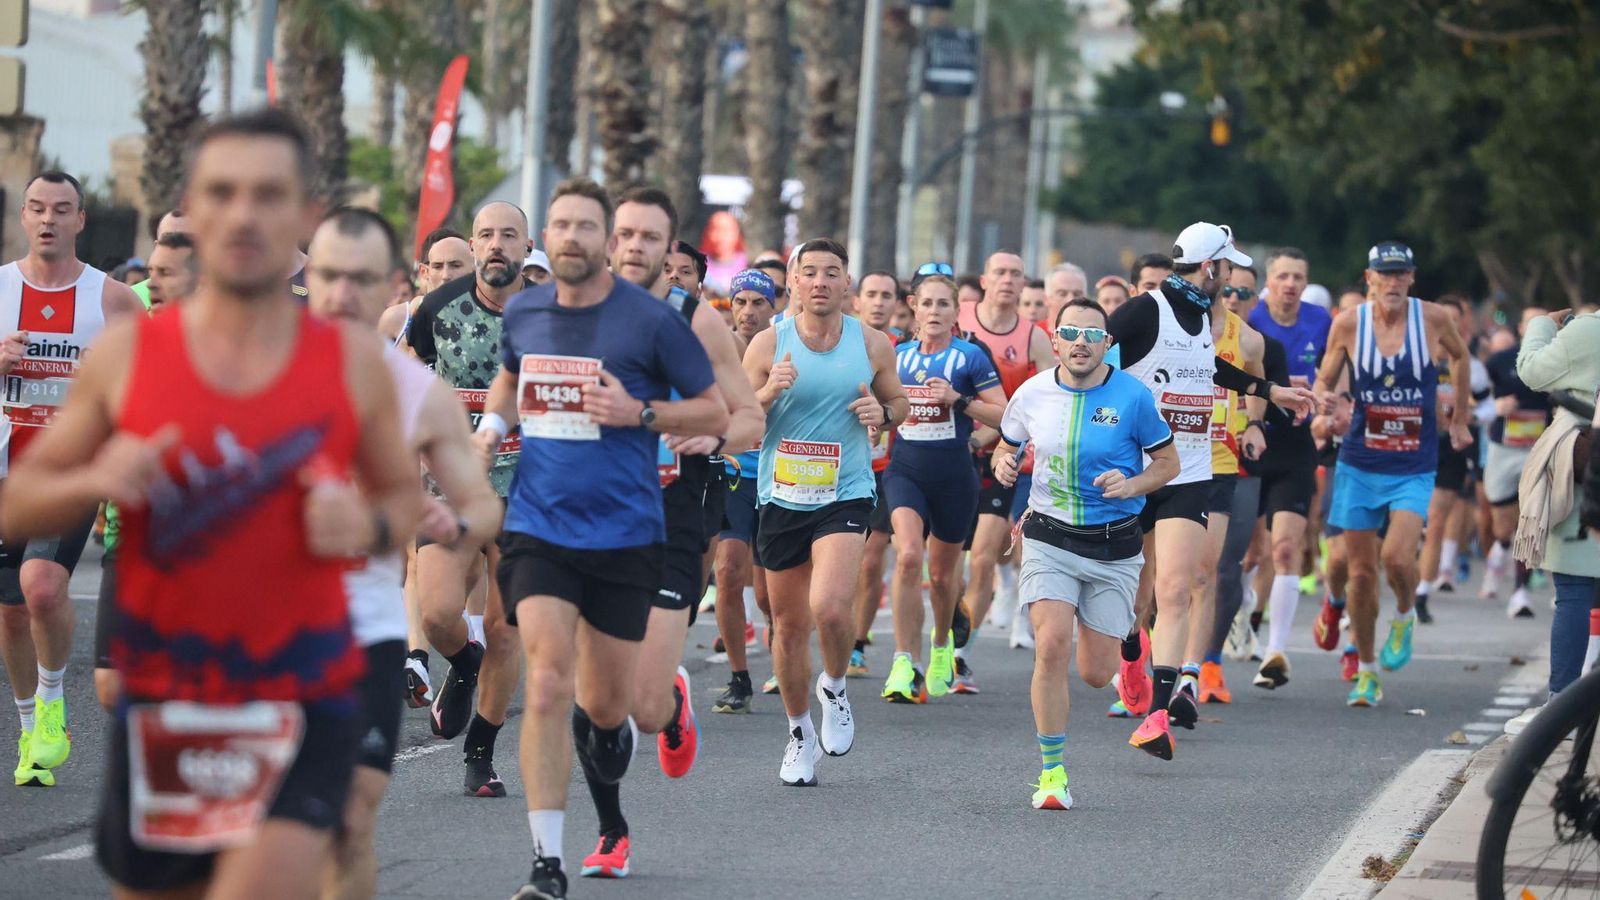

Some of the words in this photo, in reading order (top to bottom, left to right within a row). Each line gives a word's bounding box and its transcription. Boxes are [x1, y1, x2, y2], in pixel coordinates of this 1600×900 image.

[23, 383, 59, 396] 7914
[534, 384, 581, 404] 16436
[1361, 391, 1374, 403] IS
[1378, 387, 1423, 403] GÖTA
[909, 405, 941, 417] 15999
[1169, 412, 1204, 426] 13395
[788, 443, 836, 456] GENERALI
